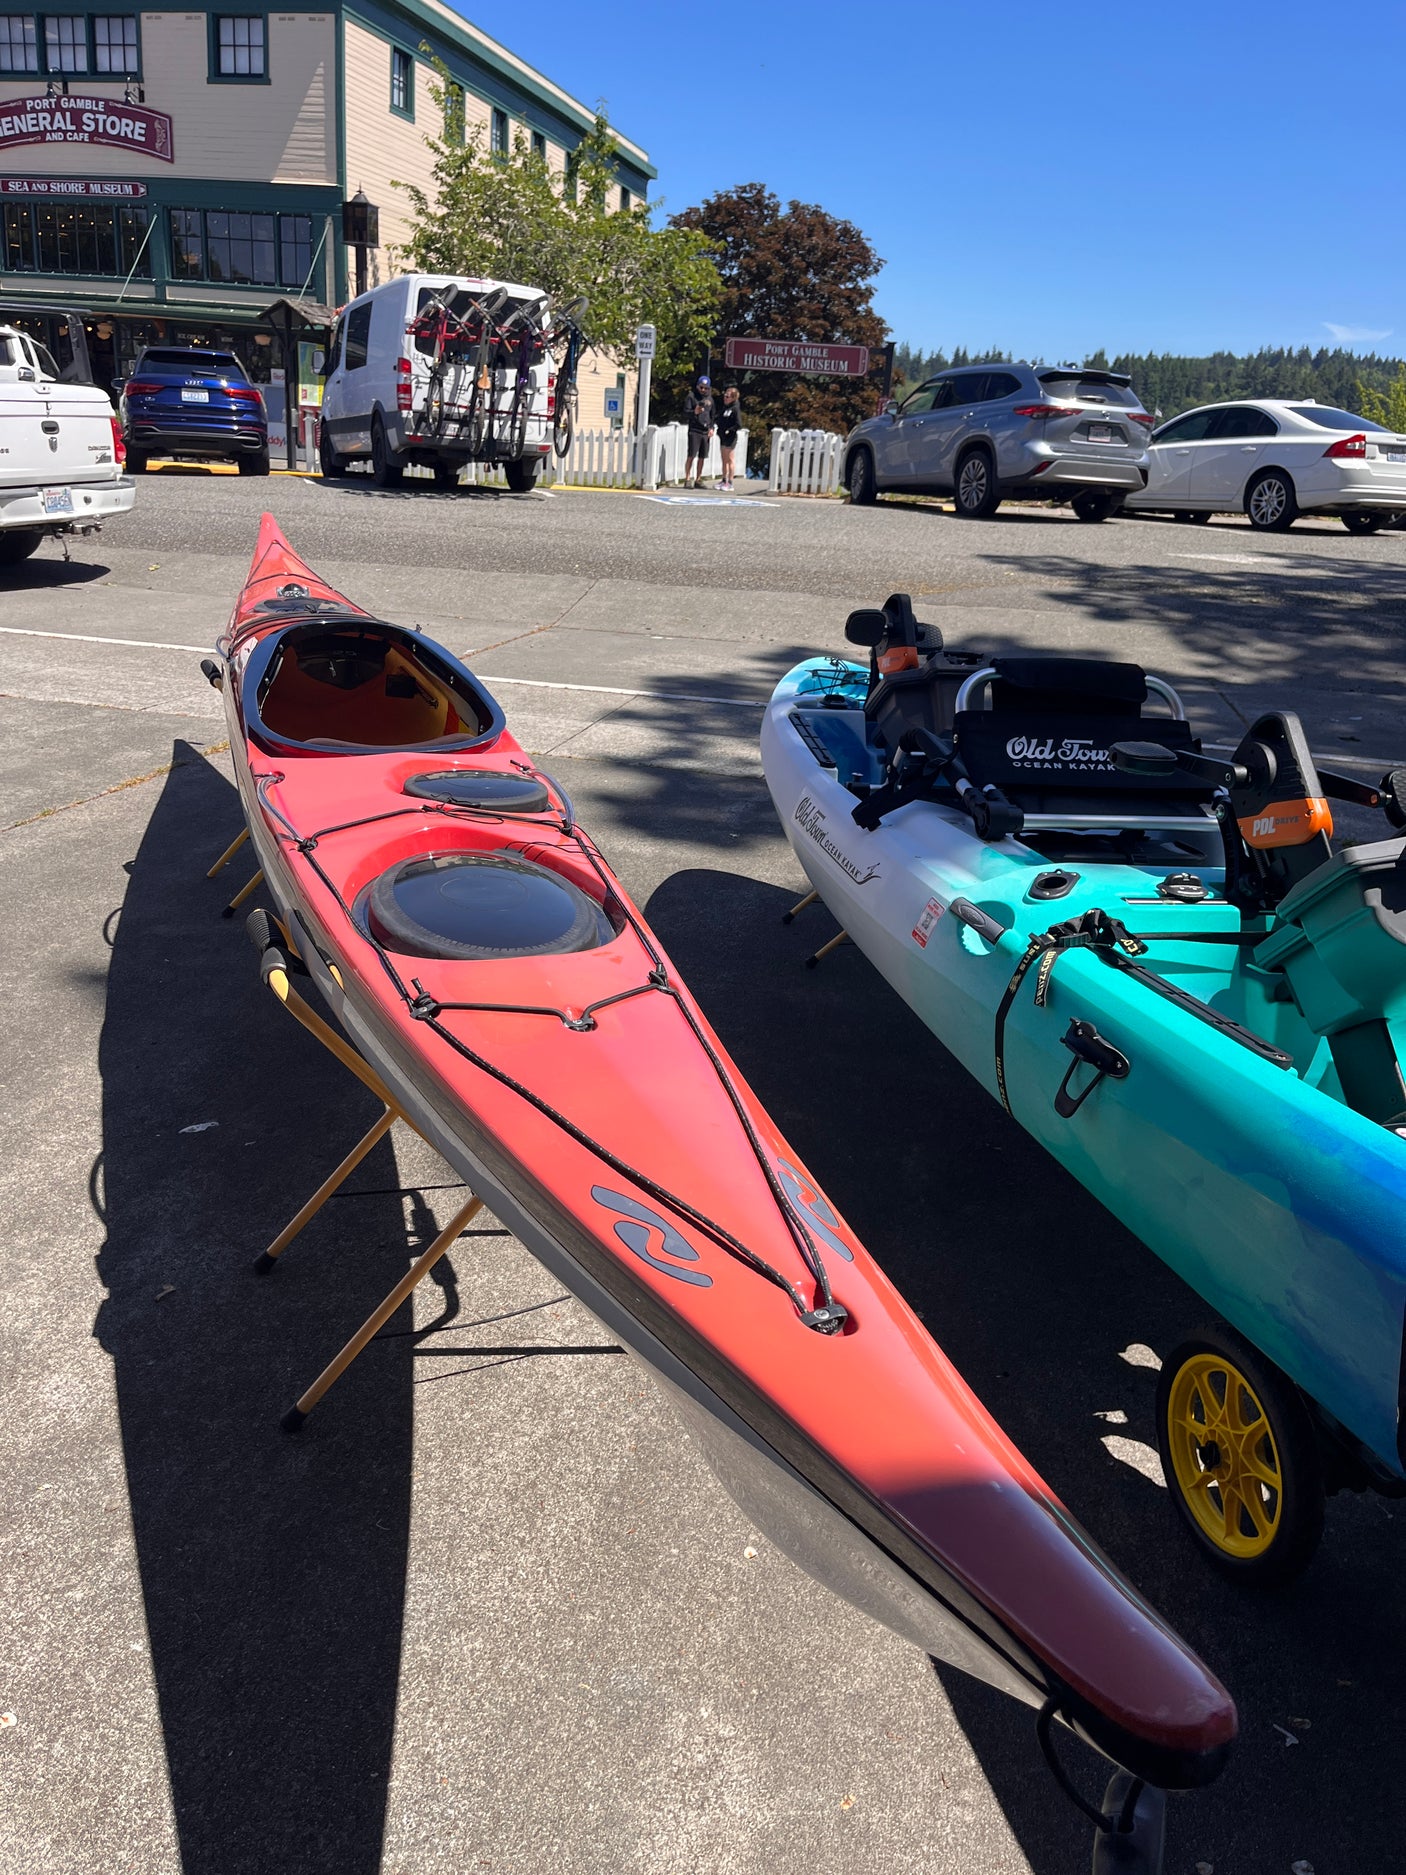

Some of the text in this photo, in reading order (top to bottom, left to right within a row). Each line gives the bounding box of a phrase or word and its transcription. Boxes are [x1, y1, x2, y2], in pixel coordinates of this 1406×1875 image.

[26, 98, 105, 111] PORT GAMBLE
[0, 111, 147, 141] ENERAL STORE
[45, 132, 90, 142] AND CAFE
[8, 181, 133, 195] SEA AND SHORE MUSEUM
[639, 331, 653, 340] ONE
[638, 342, 653, 350] WAY
[765, 343, 829, 358] PORT GAMBLE
[743, 353, 848, 372] HISTORIC MUSEUM
[1006, 735, 1110, 762] Old Tow
[1012, 761, 1116, 771] OCEAN KAYAK
[1252, 816, 1276, 837] PDL
[794, 796, 861, 879] Old Town OCEAN KAYAK
